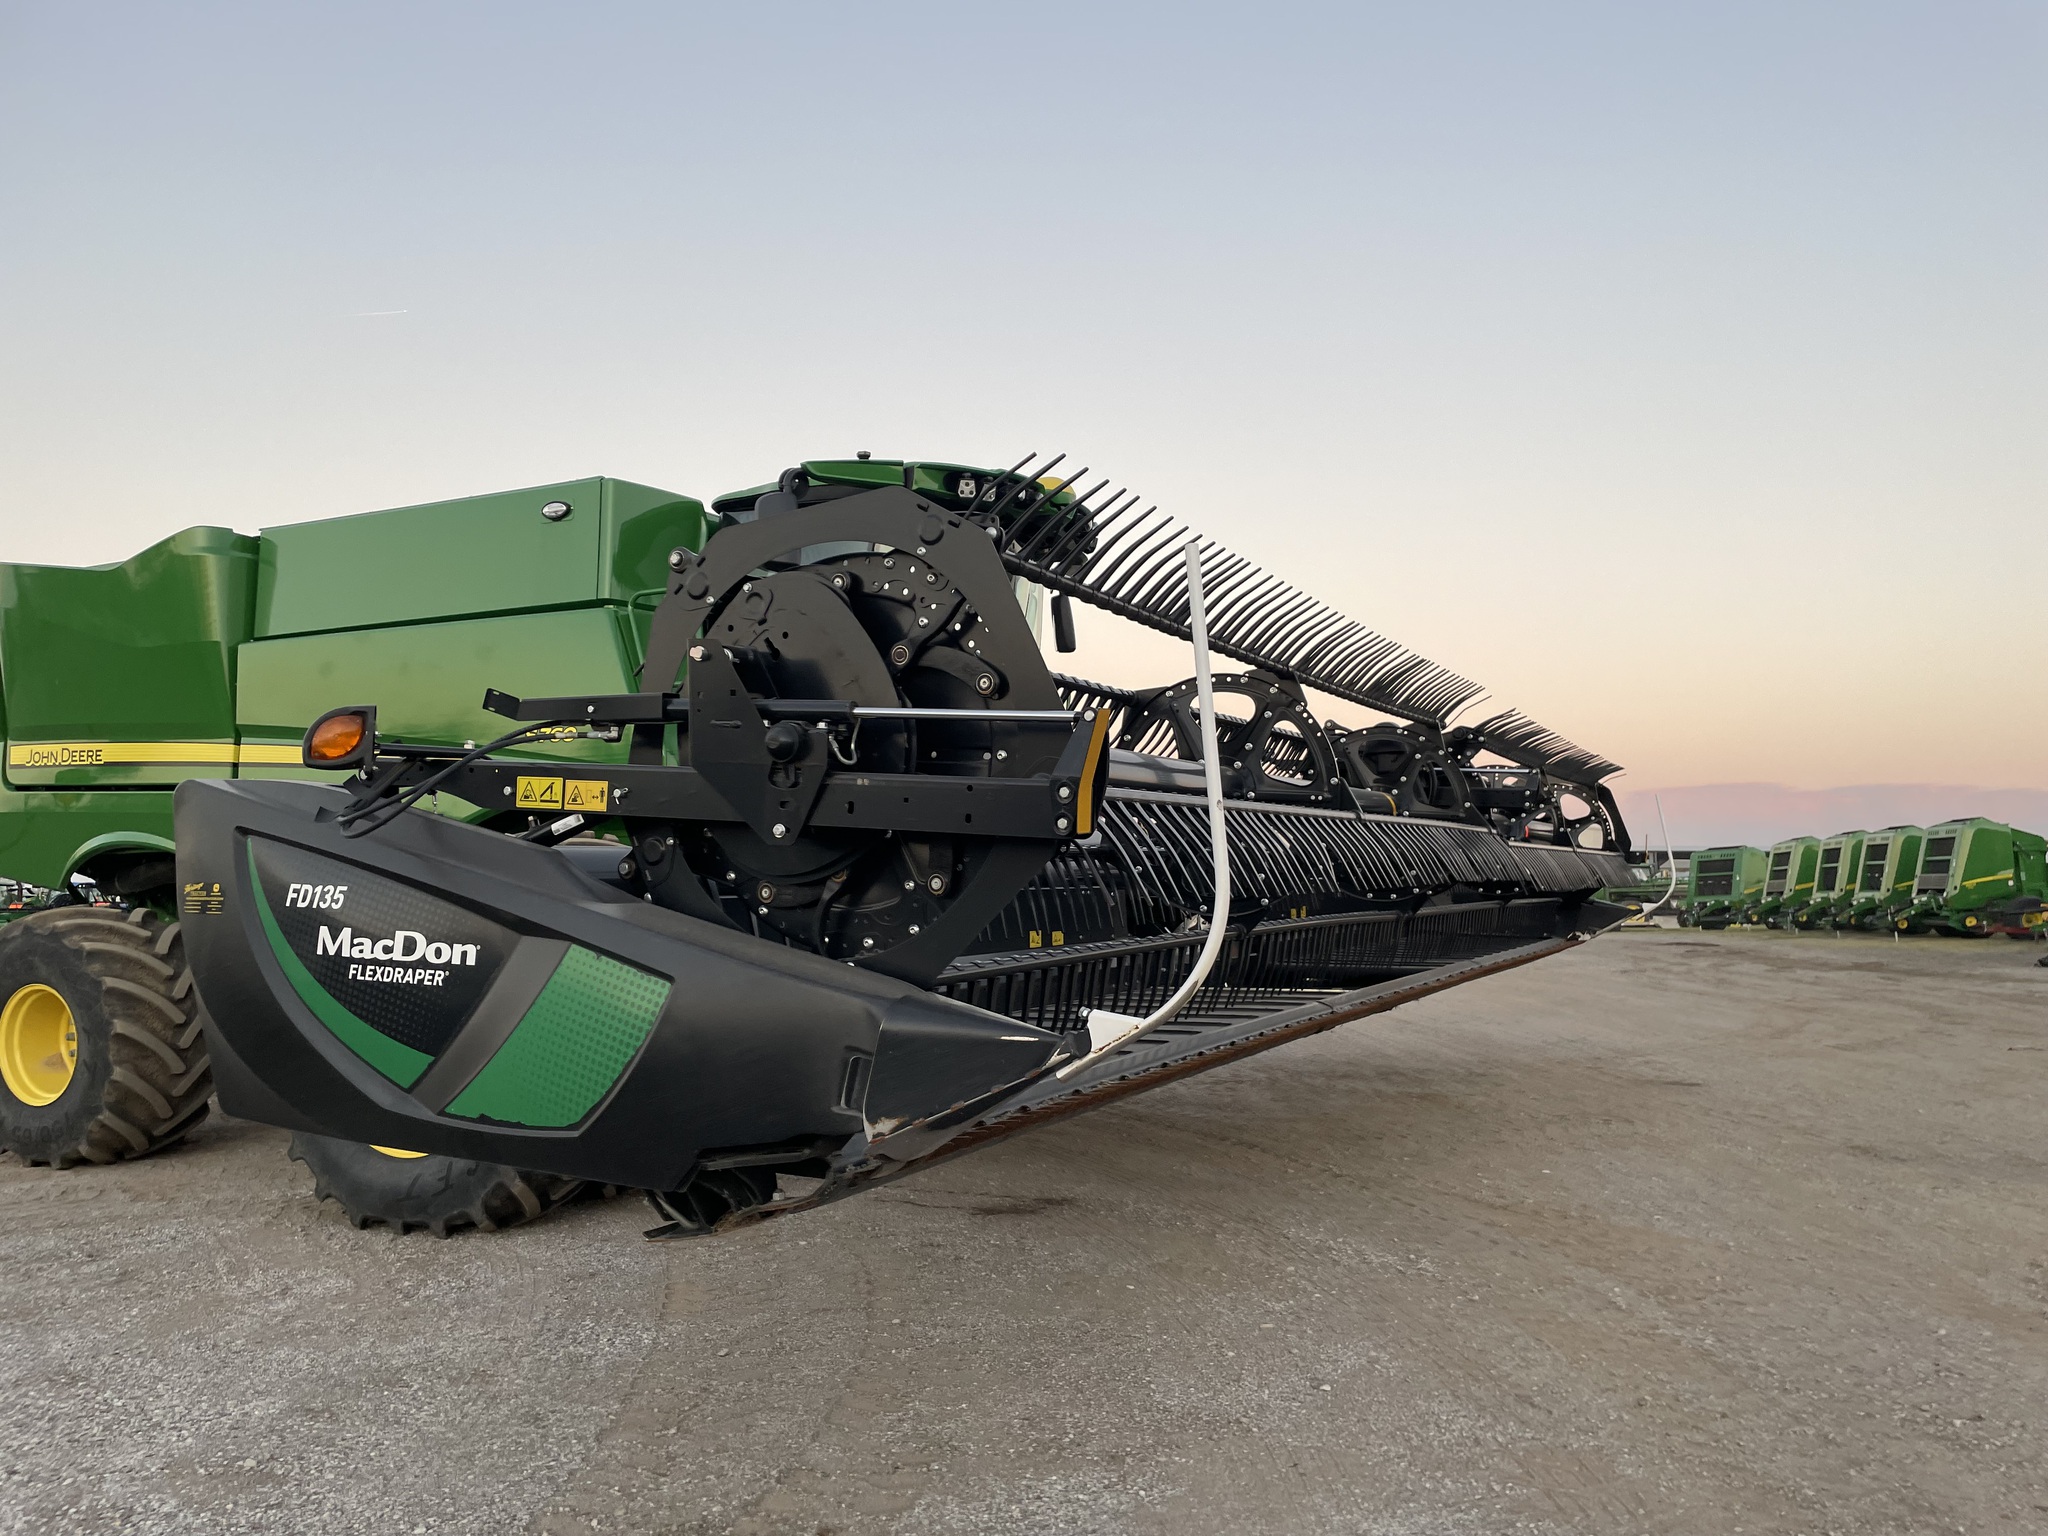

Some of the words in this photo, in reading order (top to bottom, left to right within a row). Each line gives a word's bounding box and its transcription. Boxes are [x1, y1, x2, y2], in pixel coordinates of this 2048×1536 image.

[26, 748, 59, 765] JOHN
[61, 747, 103, 763] DEERE
[285, 883, 348, 909] FD135
[316, 925, 479, 966] MacDon
[349, 964, 448, 986] FLEXDRAPER
